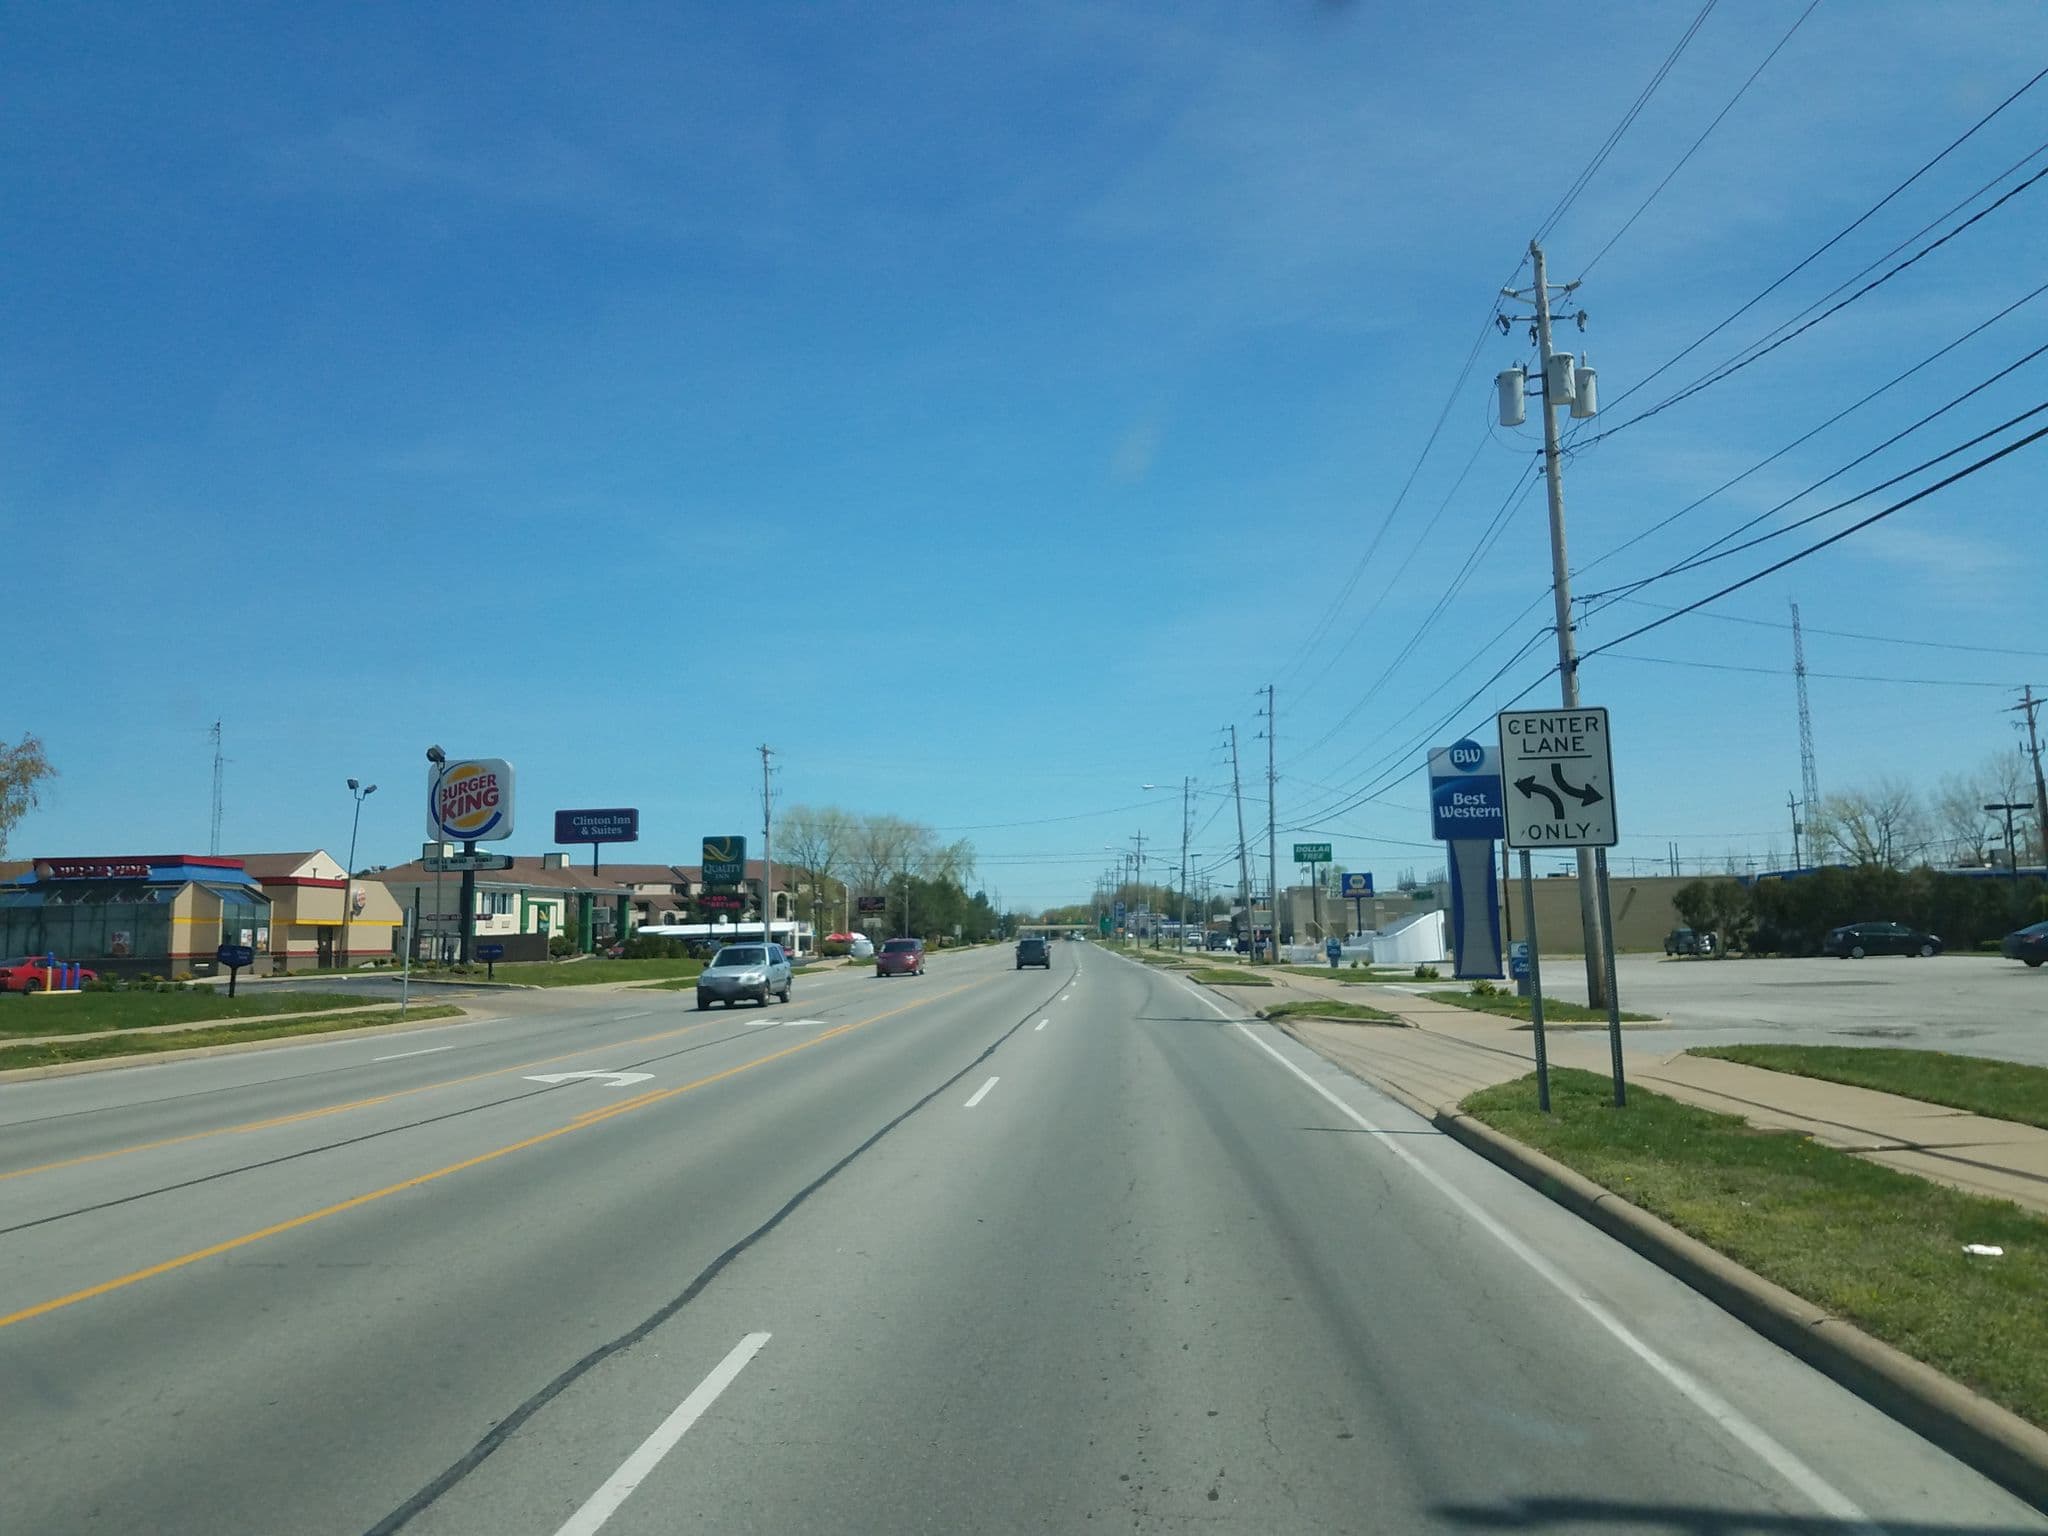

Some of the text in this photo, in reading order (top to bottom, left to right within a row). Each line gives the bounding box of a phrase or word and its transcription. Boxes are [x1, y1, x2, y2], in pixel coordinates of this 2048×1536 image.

[1508, 717, 1598, 735] CENTER
[1522, 736, 1585, 753] LANE
[1453, 749, 1481, 763] BW
[442, 774, 496, 801] BURGER
[441, 786, 499, 823] KING
[1453, 792, 1487, 805] Best
[1439, 805, 1502, 818] Western
[573, 816, 631, 826] Clinton Inn
[581, 825, 623, 835] & Suites
[1528, 823, 1591, 840] ONLY
[704, 864, 741, 874] QUALITY
